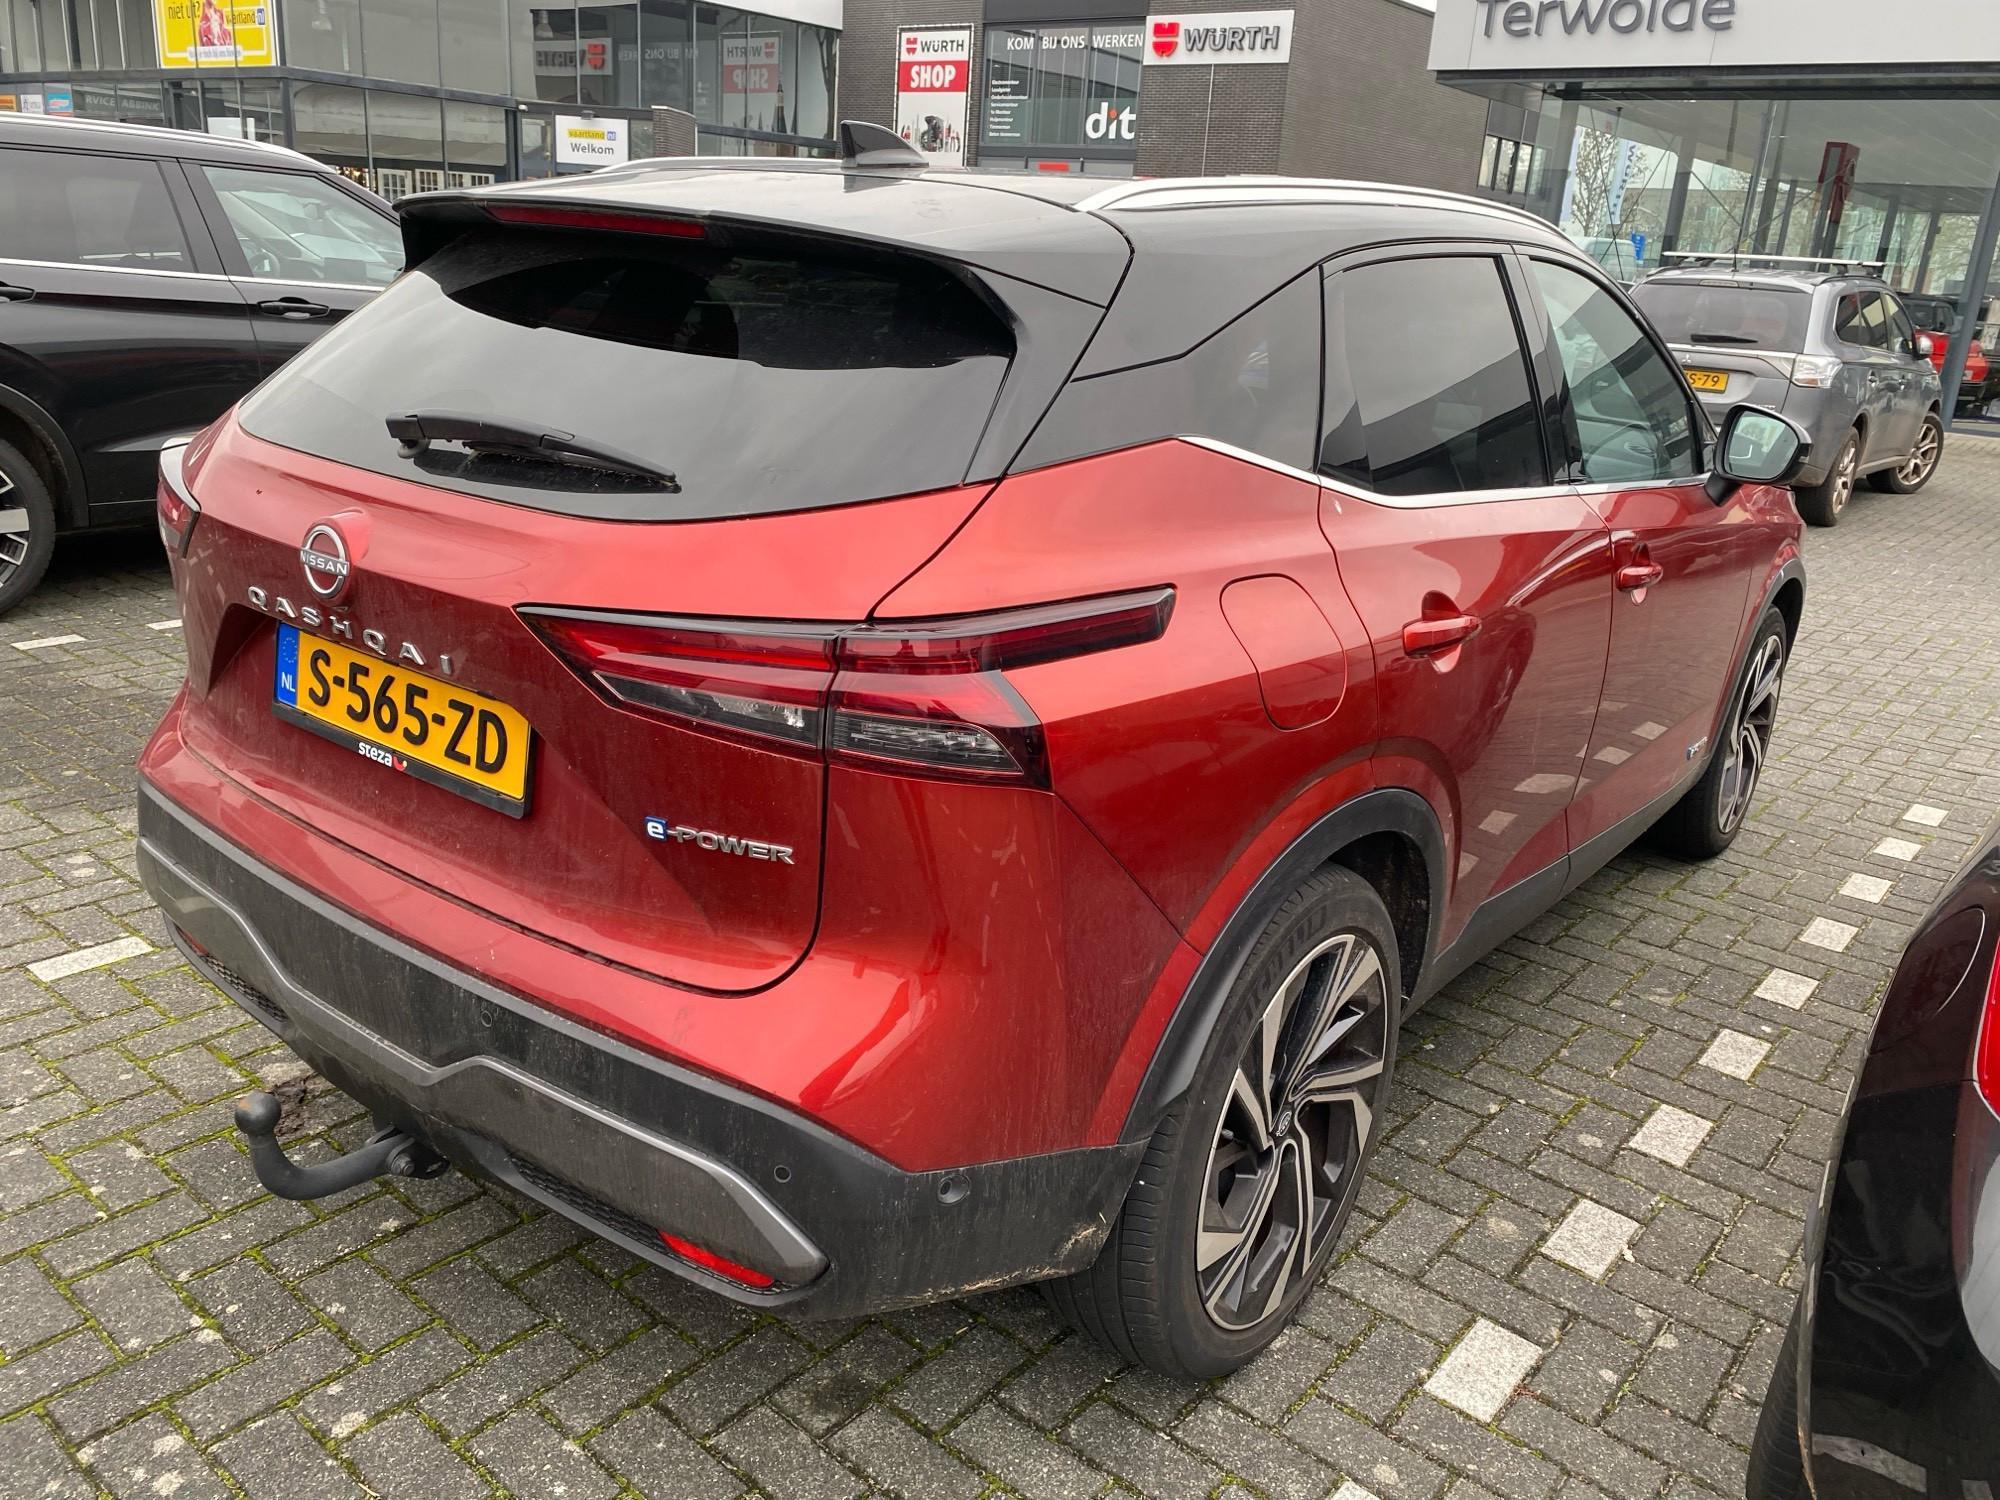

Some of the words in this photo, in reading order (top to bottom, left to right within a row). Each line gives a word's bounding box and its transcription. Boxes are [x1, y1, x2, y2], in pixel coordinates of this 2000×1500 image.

[226, 10, 256, 25] vartland
[920, 40, 965, 52] WÜRTH
[1007, 37, 1034, 50] KOM
[1042, 36, 1058, 50] BIJ
[1061, 35, 1086, 49] ONS
[1092, 33, 1144, 48] WERKEN
[1184, 26, 1281, 51] WÜRTH
[910, 64, 957, 88] SHOP
[1085, 102, 1137, 140] dit
[570, 142, 615, 155] Welkom
[1686, 372, 1720, 387] S-79
[300, 550, 348, 575] NISSAN
[248, 586, 453, 674] QASHQAI
[281, 672, 296, 692] NL
[309, 649, 508, 774] S-565-ZD
[358, 742, 392, 767] steza
[646, 818, 795, 865] e-POWER
